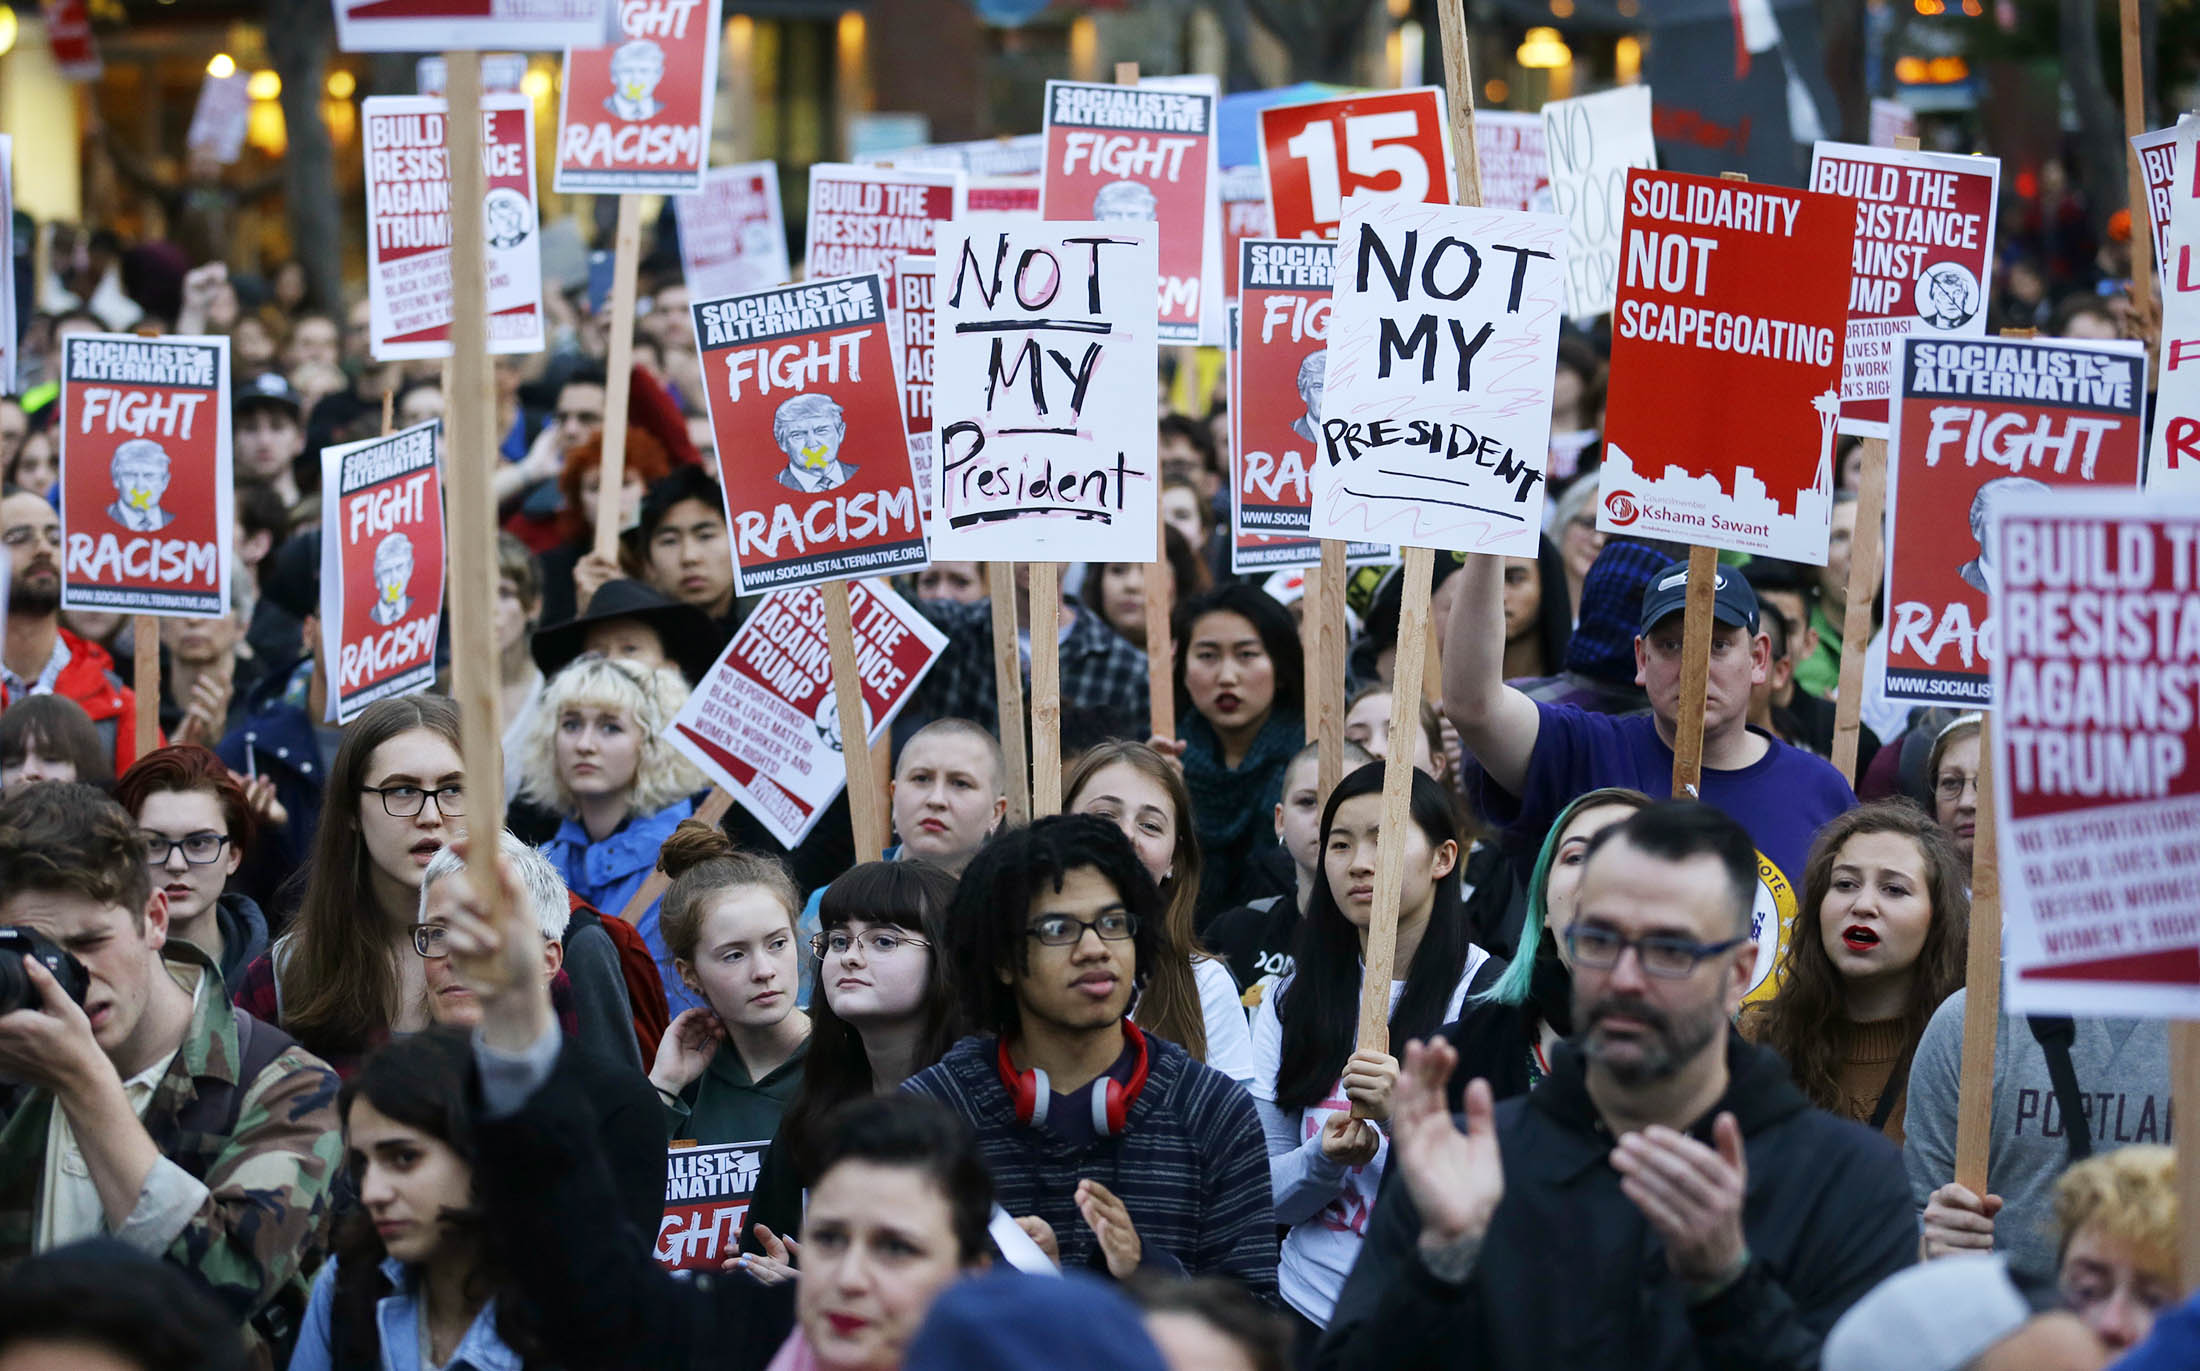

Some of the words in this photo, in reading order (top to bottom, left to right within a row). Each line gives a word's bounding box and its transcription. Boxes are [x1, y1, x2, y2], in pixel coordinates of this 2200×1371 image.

[620, 0, 702, 39] GHT
[1054, 104, 1205, 132] ALTERNATIVE
[1055, 86, 1182, 114] SOCIALIST
[373, 114, 444, 149] BUILD
[564, 122, 701, 168] RACISM
[1063, 131, 1197, 183] FIGHT
[1547, 100, 1593, 176] NO
[1288, 110, 1430, 224] 15
[1818, 159, 1900, 202] BUILD
[1906, 169, 1959, 210] THE
[376, 181, 451, 216] AGAIN
[818, 181, 882, 214] BUILD
[885, 184, 929, 218] THE
[1630, 177, 1801, 237] SOLIDARITY
[815, 212, 936, 250] RESISTANC
[1855, 201, 1981, 250] SISTANCE
[948, 233, 1142, 314] NOT
[1251, 245, 1336, 267] SOCIA
[1356, 222, 1556, 314] NOT
[1625, 228, 1718, 297] NOT
[1851, 239, 1929, 281] AINST
[702, 283, 842, 327] SOCIALIST
[707, 298, 877, 346] ALTERNATIVE
[1262, 294, 1332, 344] FIG
[1846, 320, 1912, 341] RTATIONS!
[72, 339, 189, 367] SOCIALIST
[1377, 313, 1496, 392] MY
[1620, 299, 1834, 368] SCAPEGOATING
[71, 359, 214, 386] ALTERNATIVE
[725, 329, 872, 402] FIGHT
[985, 337, 1103, 417] MY
[1912, 366, 2133, 409] ALTERNATIVE
[1914, 343, 2094, 380] SOCIALIST
[81, 387, 208, 440] FIGHT
[942, 421, 1146, 512] President
[1322, 417, 1544, 503] PRESIDENT
[1926, 406, 2121, 481] FIGHT
[350, 472, 431, 545] FIGHT
[735, 486, 915, 558] RACISM
[1642, 504, 1705, 527] Kshama
[1711, 514, 1769, 538] Sawant
[67, 532, 218, 587] RACISM
[743, 545, 924, 587] WWW.SOCIALISTALTERNATIVE.ORG
[2005, 522, 2156, 589] BUILD
[339, 612, 437, 688] RACISM
[754, 602, 834, 687] AGAINS
[857, 599, 910, 657] THE
[2006, 595, 2200, 660] RESISTA
[719, 667, 734, 686] NO
[737, 627, 816, 703] TRUMP
[695, 716, 742, 752] WOMEN'S
[702, 699, 742, 731] DEFEND
[790, 754, 813, 777] AND
[709, 683, 742, 709] BLACK
[742, 700, 771, 730] LIVES
[771, 720, 814, 755] MATTER!
[2007, 728, 2186, 797] TRUMP
[1758, 862, 1786, 898] OTE.
[652, 1204, 750, 1266] GHT
